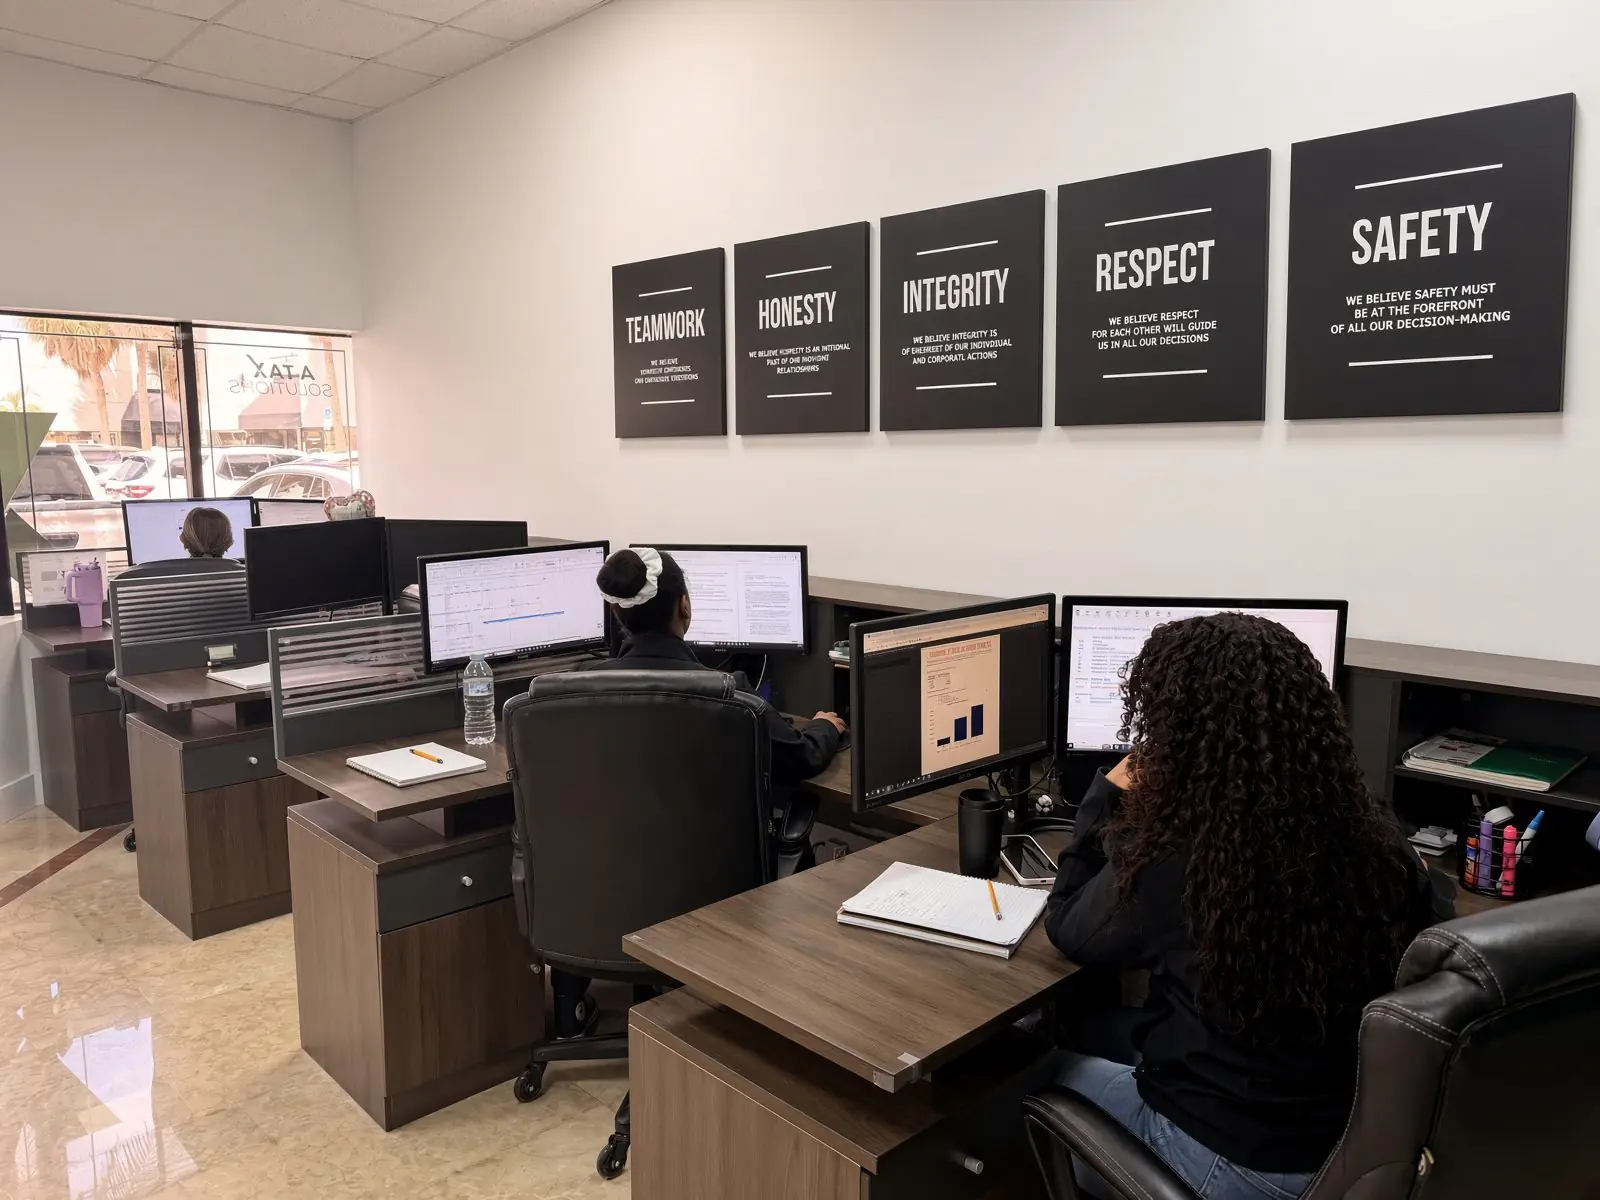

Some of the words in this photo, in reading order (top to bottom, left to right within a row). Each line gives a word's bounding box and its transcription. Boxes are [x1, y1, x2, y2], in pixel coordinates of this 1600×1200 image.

[1352, 202, 1493, 265] SAFETY
[1096, 240, 1215, 292] RESPECT
[904, 268, 1009, 314] INTEGRITY
[1346, 295, 1363, 306] WE
[1366, 291, 1411, 304] BELIEVE
[1415, 287, 1458, 300] SAFETY
[1461, 283, 1496, 295] MUST
[759, 291, 837, 330] HONESTY
[1109, 317, 1121, 326] WE
[1125, 313, 1158, 324] BELIEVE
[1161, 310, 1199, 321] RESPECT
[1355, 309, 1368, 319] BE
[1371, 307, 1385, 318] AT
[1388, 304, 1409, 316] THE
[1413, 299, 1484, 314] FOREFRONT
[626, 308, 705, 344] TEAMWORK
[1092, 330, 1107, 339] FOR
[1110, 328, 1131, 338] EACH
[1134, 325, 1161, 336] OTHER
[1164, 323, 1185, 333] WILL
[1188, 321, 1217, 331] GUIDE
[1331, 324, 1345, 334] OF
[1348, 321, 1366, 333] ALL
[1370, 319, 1393, 331] OUR
[1397, 311, 1511, 329] DECISION-MAKING
[952, 330, 988, 341] INTEGRITY
[990, 329, 998, 337] IS
[1098, 341, 1108, 350] US
[1111, 340, 1120, 349] IN
[1122, 339, 1137, 348] ALL
[1140, 338, 1157, 347] OUR
[1160, 333, 1209, 345] DECISIONS
[902, 348, 910, 356] OF
[955, 342, 968, 351] OUR
[913, 356, 926, 365] AND
[967, 351, 998, 361] ACTIONS
